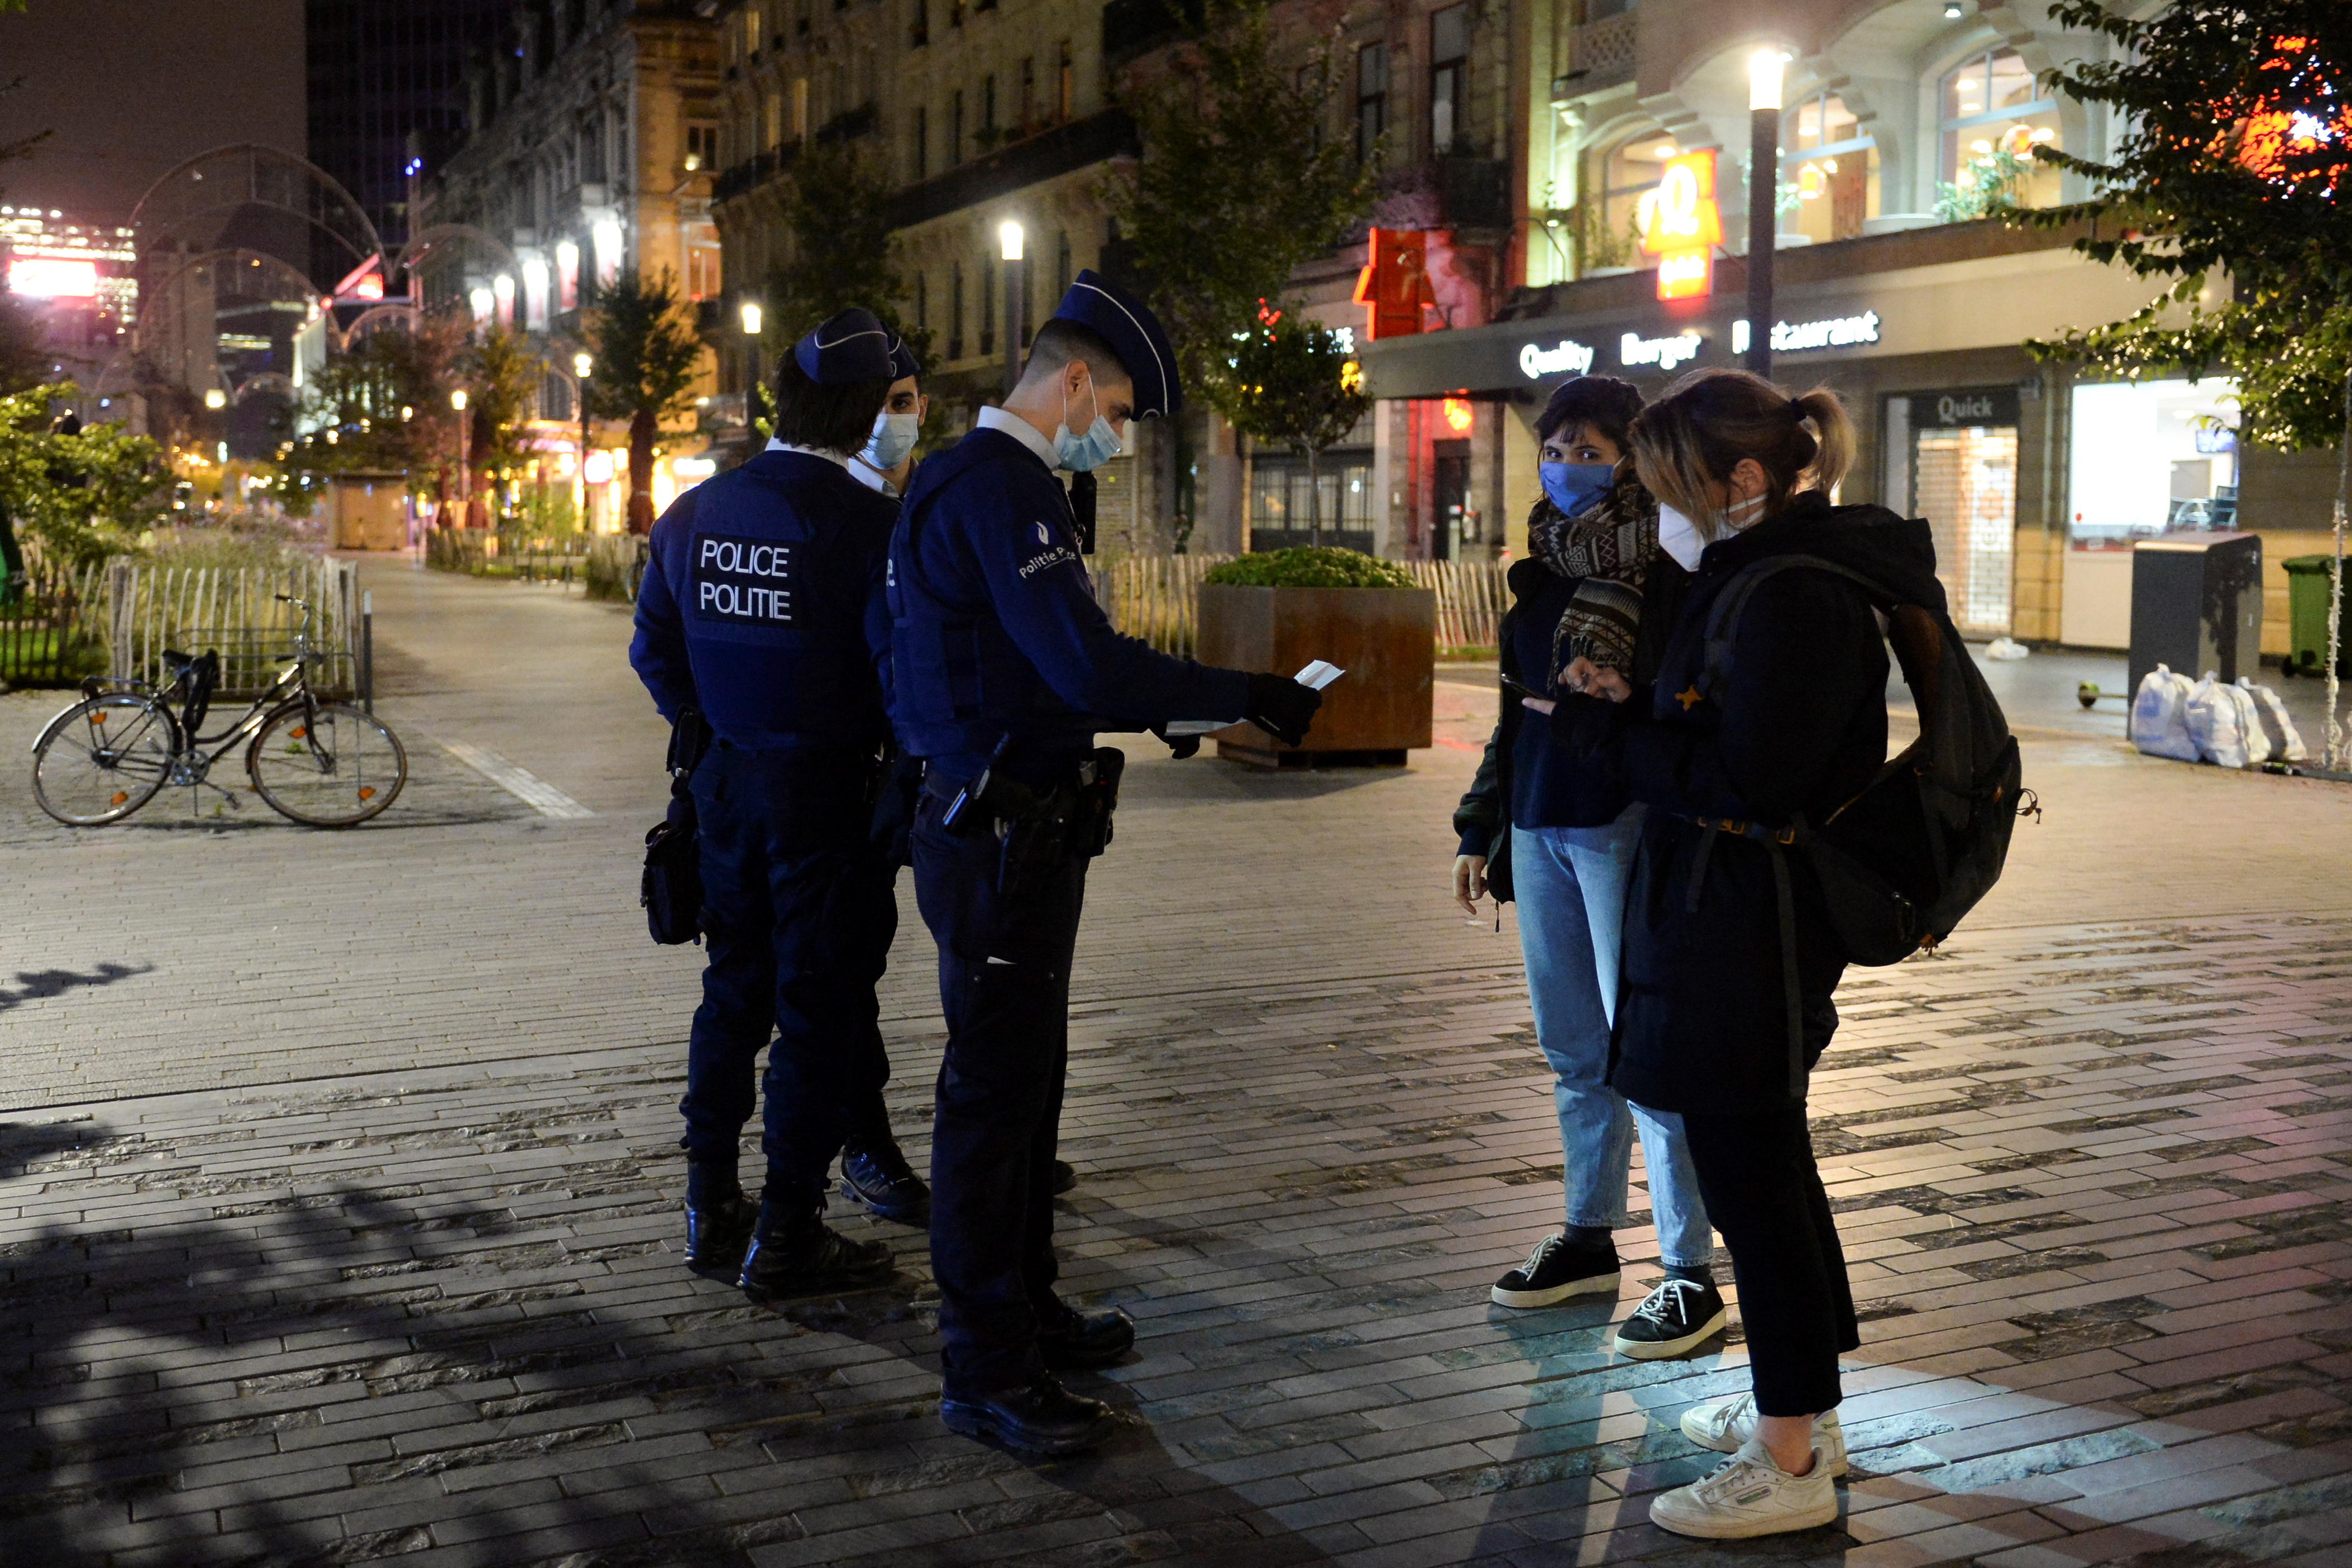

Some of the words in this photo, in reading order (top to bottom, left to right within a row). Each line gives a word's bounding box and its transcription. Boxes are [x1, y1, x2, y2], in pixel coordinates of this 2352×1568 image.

[1520, 340, 1594, 379] Quality
[1621, 333, 1702, 370] Burger
[1732, 310, 1878, 354] Rtaurant
[1938, 395, 1992, 424] Quick
[700, 539, 790, 577] POLICE
[1019, 552, 1057, 579] Politie
[700, 582, 792, 620] POLITIE
